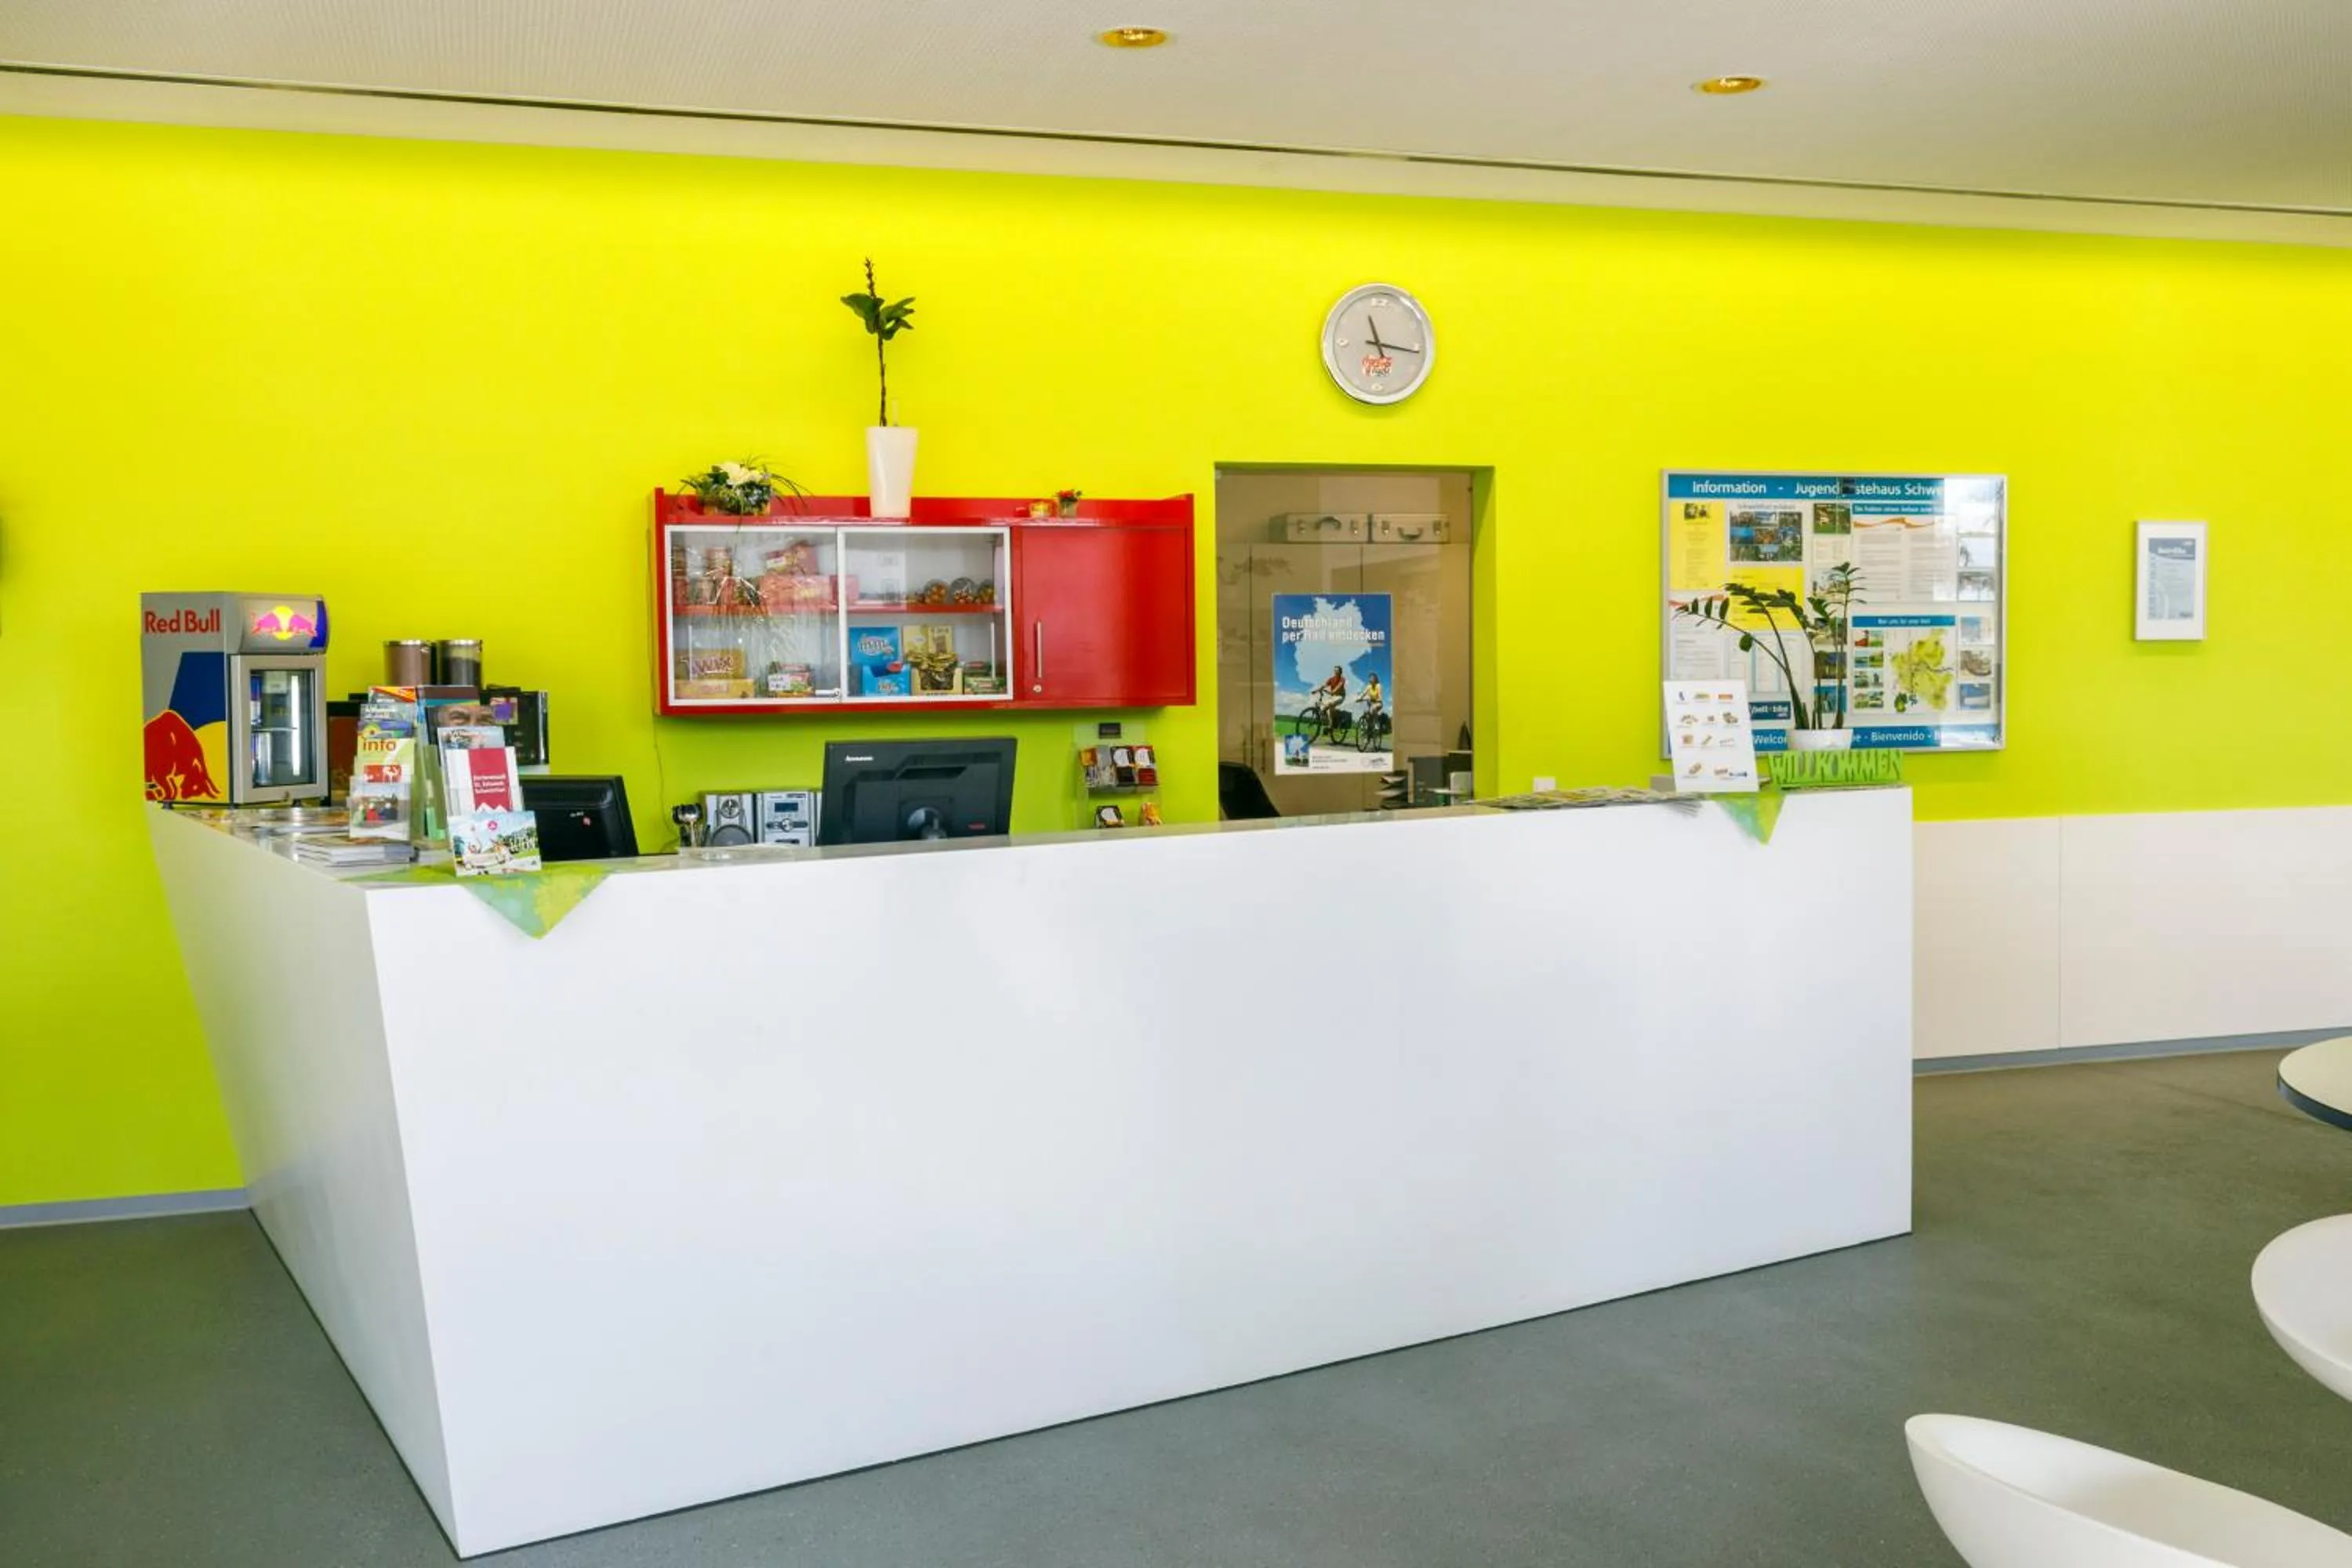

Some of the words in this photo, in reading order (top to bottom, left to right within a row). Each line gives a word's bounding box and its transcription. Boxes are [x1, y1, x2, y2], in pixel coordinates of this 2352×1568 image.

[1693, 481, 1766, 494] Information
[144, 610, 180, 633] Red
[184, 608, 220, 633] Bull
[1282, 630, 1301, 644] per
[1753, 734, 1787, 744] Welco
[1871, 731, 1925, 742] Bienvenido
[364, 738, 396, 751] info
[1769, 750, 1904, 784] WILLKOMMEN
